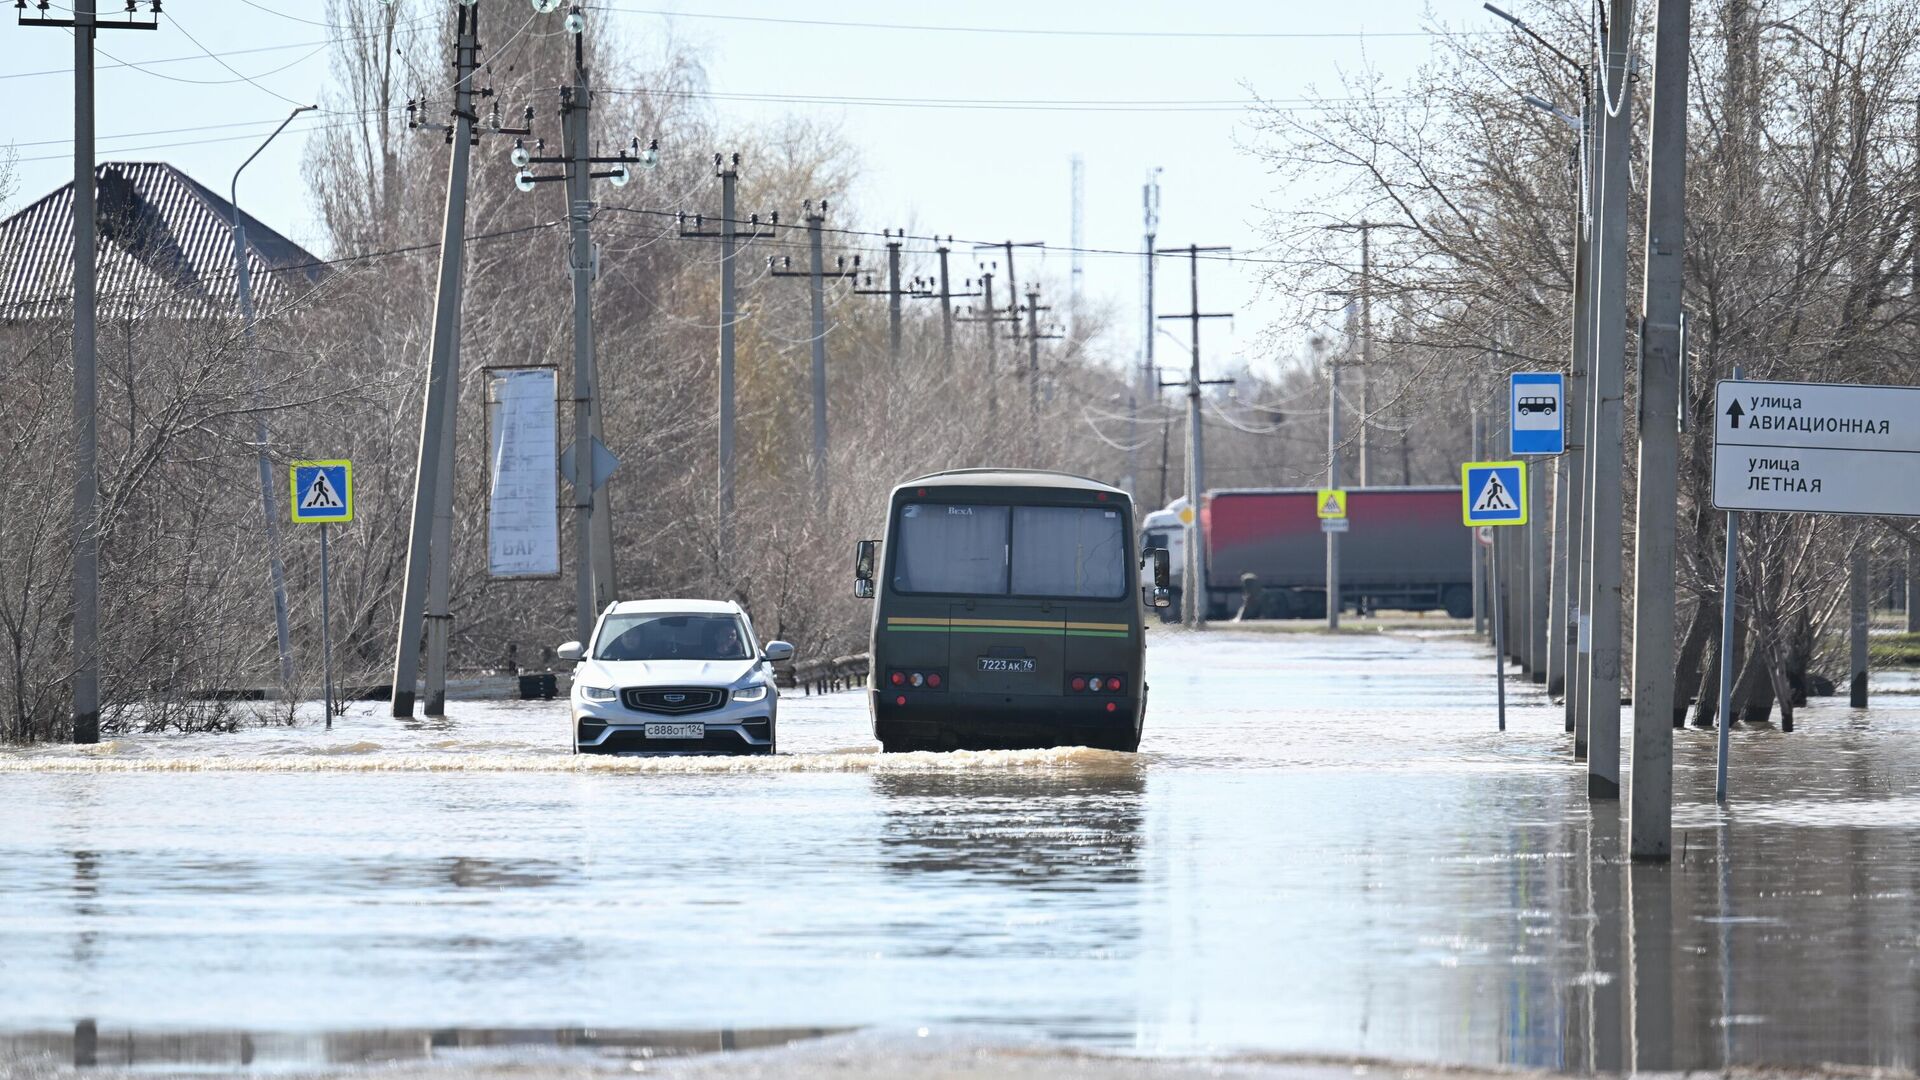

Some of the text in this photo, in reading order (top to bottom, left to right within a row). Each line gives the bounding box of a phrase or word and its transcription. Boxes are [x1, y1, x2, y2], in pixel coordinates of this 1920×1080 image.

[1750, 396, 1802, 411] улица
[1749, 415, 1890, 435] АВИАЦИОННАЯ
[1748, 457, 1800, 473] улица
[1747, 476, 1822, 493] ЛЕТНАЯ
[982, 660, 1033, 670] 7223 АК 76
[647, 725, 685, 735] С888ОТ
